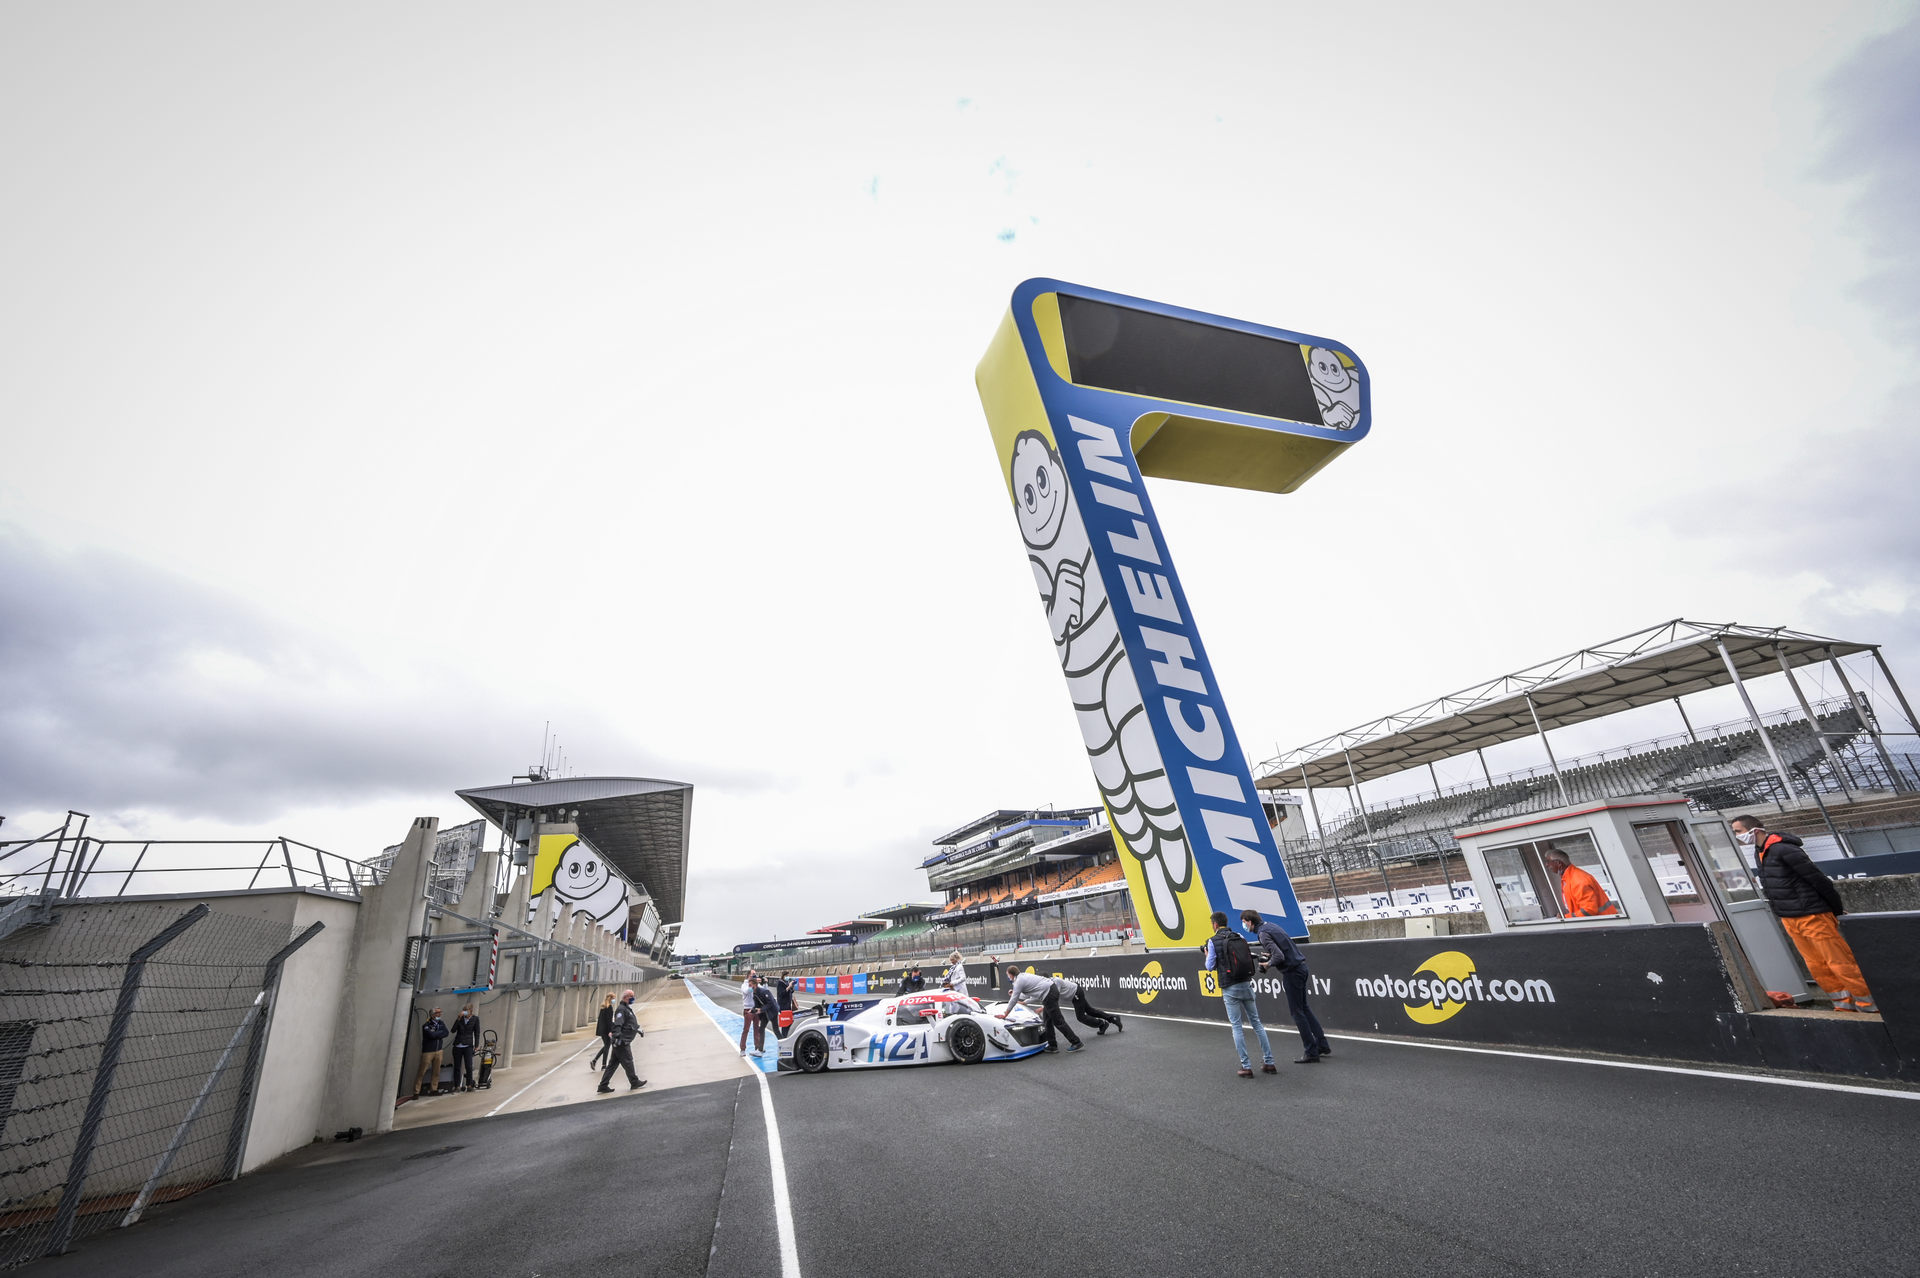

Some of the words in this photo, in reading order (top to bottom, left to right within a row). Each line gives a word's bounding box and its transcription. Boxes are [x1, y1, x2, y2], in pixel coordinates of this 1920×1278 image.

[1066, 413, 1288, 918] MICHELIN
[1119, 974, 1188, 993] motorsport.com
[1355, 974, 1556, 1009] motorsport.com
[902, 996, 935, 1005] TOTAL
[830, 1035, 843, 1050] 42
[868, 1031, 929, 1063] H24
